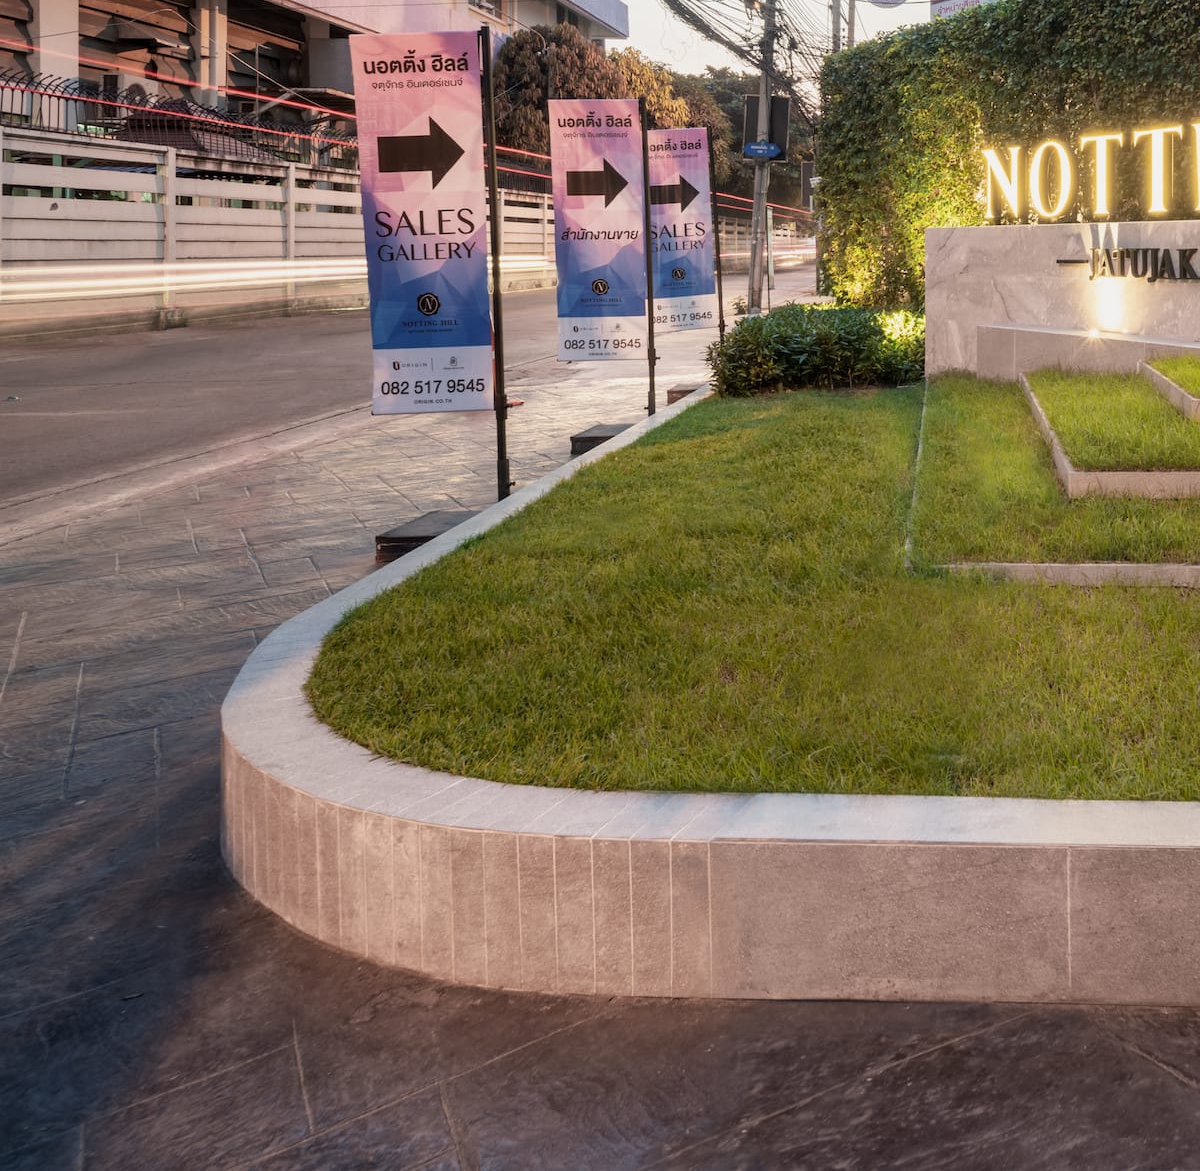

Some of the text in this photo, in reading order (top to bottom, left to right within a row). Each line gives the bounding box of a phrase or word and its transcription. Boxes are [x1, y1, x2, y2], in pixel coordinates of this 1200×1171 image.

[363, 49, 469, 75] นอตติ้ง ฮิลล์
[371, 77, 464, 91] จตุจักร อินเตอร์เชนจ์
[557, 111, 633, 128] นอตติ้ง ฮิลล์
[649, 138, 678, 152] อตติ้ง
[374, 208, 475, 238] SALES
[650, 221, 706, 240] SALES
[561, 226, 639, 241] สำนักงานขาย
[377, 241, 477, 263] GALLERY
[1088, 247, 1200, 283] JATUJAK
[670, 313, 687, 323] 517
[689, 311, 713, 321] 9545
[564, 338, 641, 350] 082 517 9545
[381, 378, 485, 396] 082 517 9545
